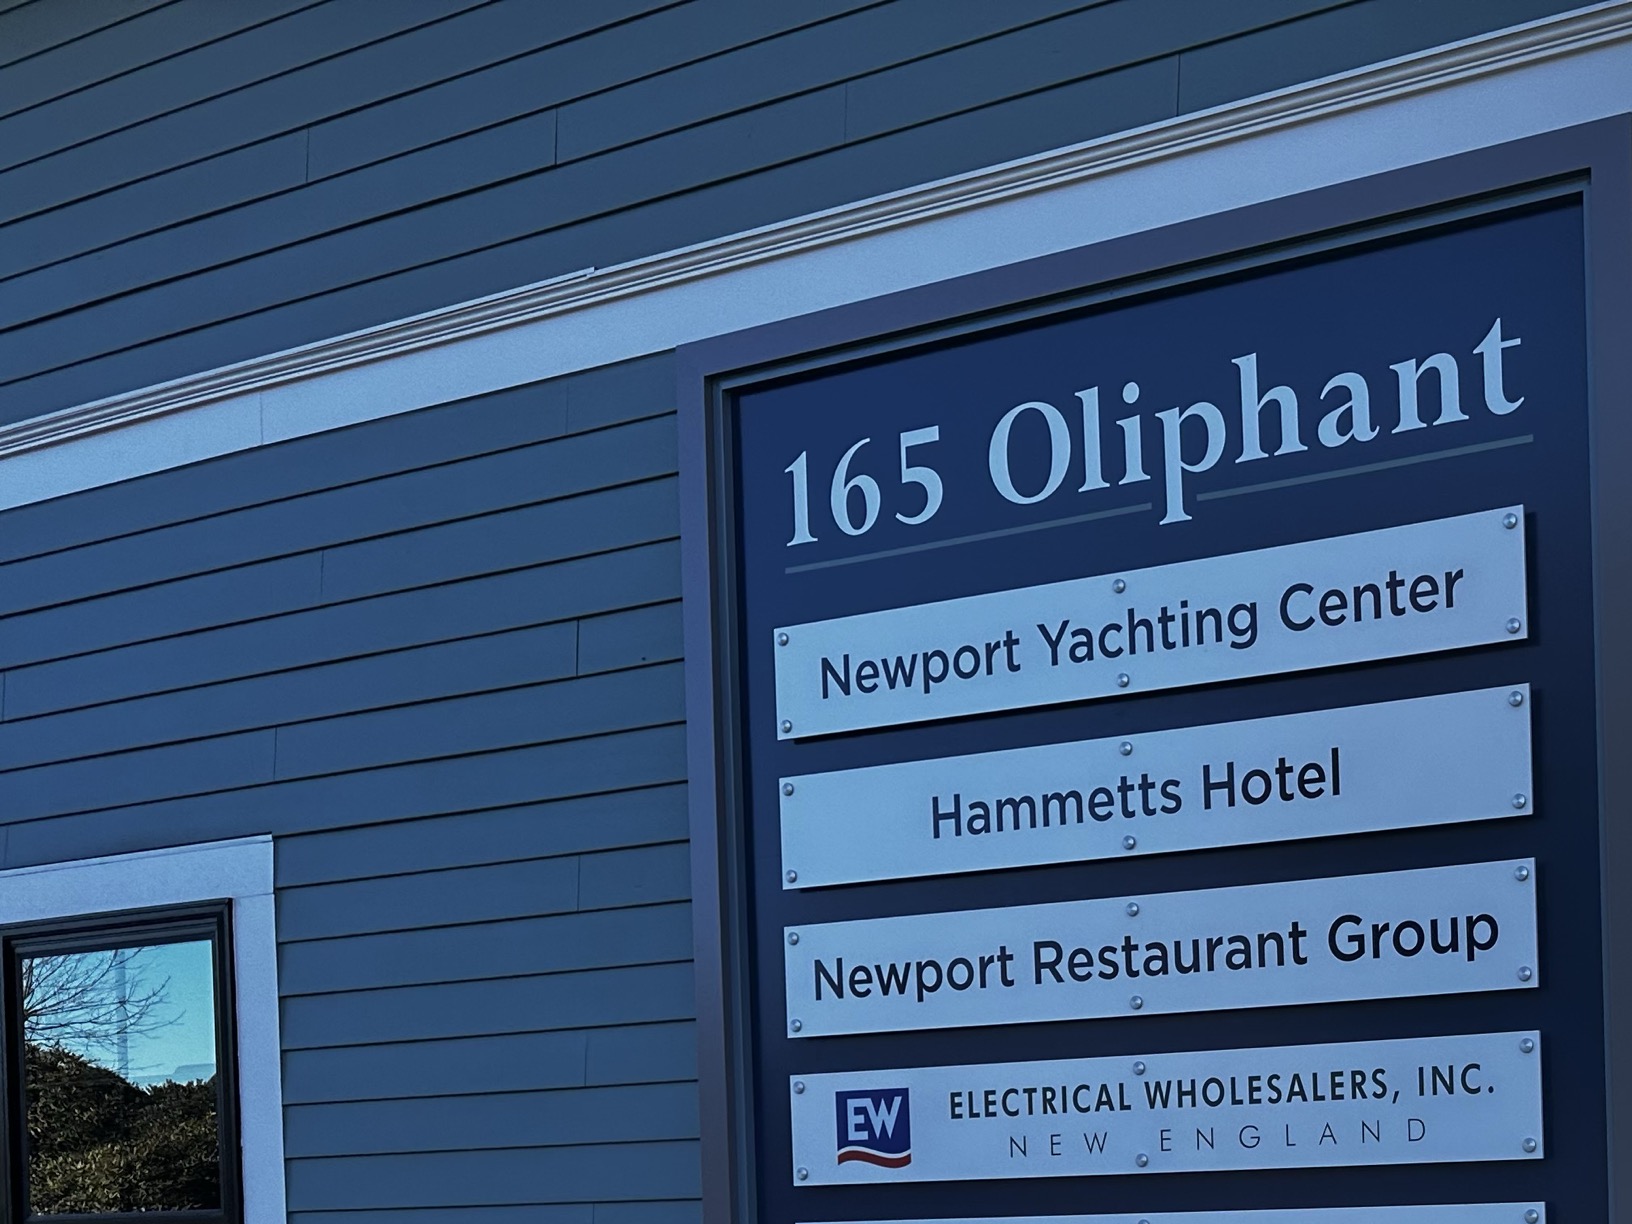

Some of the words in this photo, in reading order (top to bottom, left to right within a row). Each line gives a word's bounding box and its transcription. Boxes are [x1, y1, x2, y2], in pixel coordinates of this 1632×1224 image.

[785, 426, 944, 547] 165
[988, 317, 1525, 526] Oliphant
[820, 629, 1021, 701] Newport
[1036, 596, 1258, 667] Yachting
[1279, 568, 1464, 632] Center
[931, 773, 1183, 841] Hammetts
[1202, 747, 1342, 811] Hotel
[813, 945, 1015, 1003] Newport
[1033, 921, 1308, 985] Restaurant
[1328, 911, 1500, 962] Group
[846, 1095, 902, 1141] EW
[949, 1082, 1132, 1120] ELECTRICAL
[1144, 1068, 1400, 1110] WHOLESALERS,
[1418, 1062, 1495, 1097] INC.
[1009, 1131, 1108, 1158] NEW
[1160, 1118, 1428, 1152] ENGLAND
